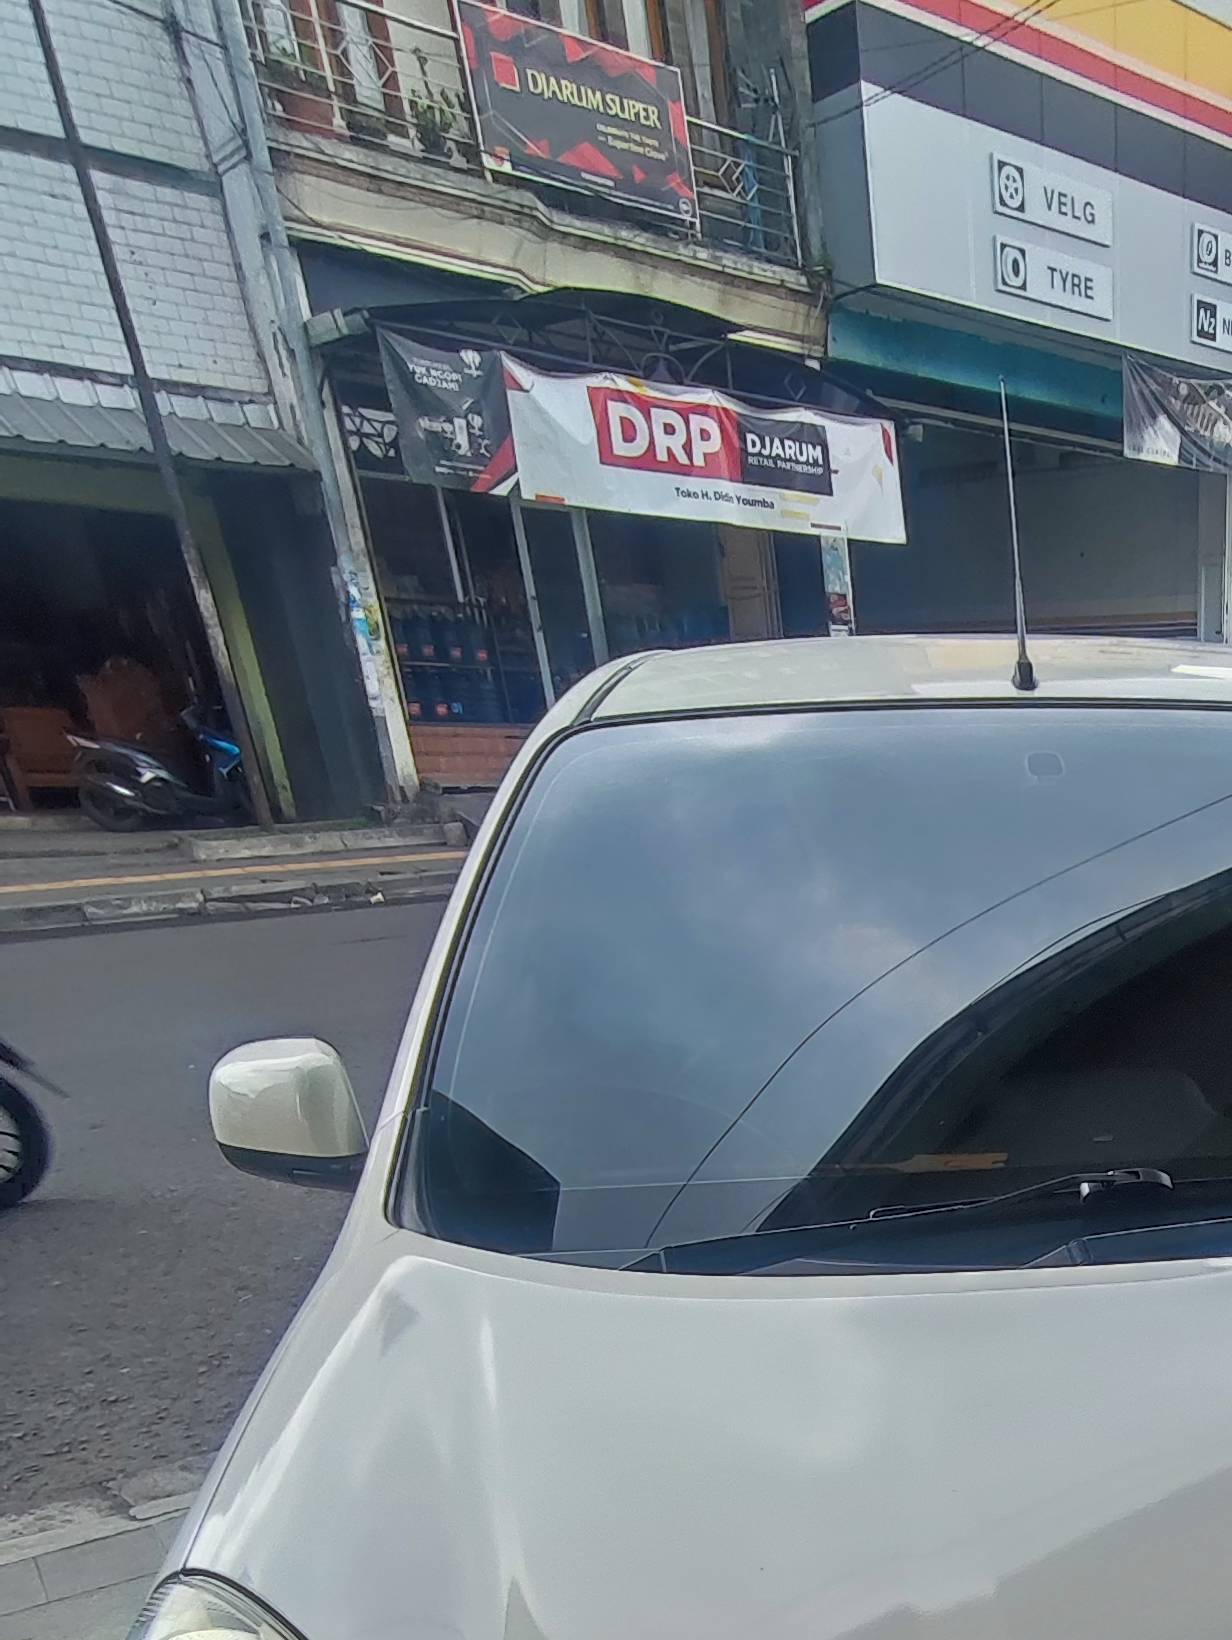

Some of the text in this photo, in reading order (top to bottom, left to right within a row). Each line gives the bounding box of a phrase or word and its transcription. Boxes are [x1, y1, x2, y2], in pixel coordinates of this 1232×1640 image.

[526, 68, 662, 129] DJARUM SUPER
[1043, 186, 1096, 224] VELG
[1047, 266, 1095, 300] TYRE
[606, 400, 722, 467] DRP
[745, 432, 824, 465] DJARUM
[747, 455, 824, 476] RETAIL PARTNERSHIP
[674, 487, 700, 500] Toko
[701, 490, 713, 501] H.
[735, 494, 776, 510] Youmba
